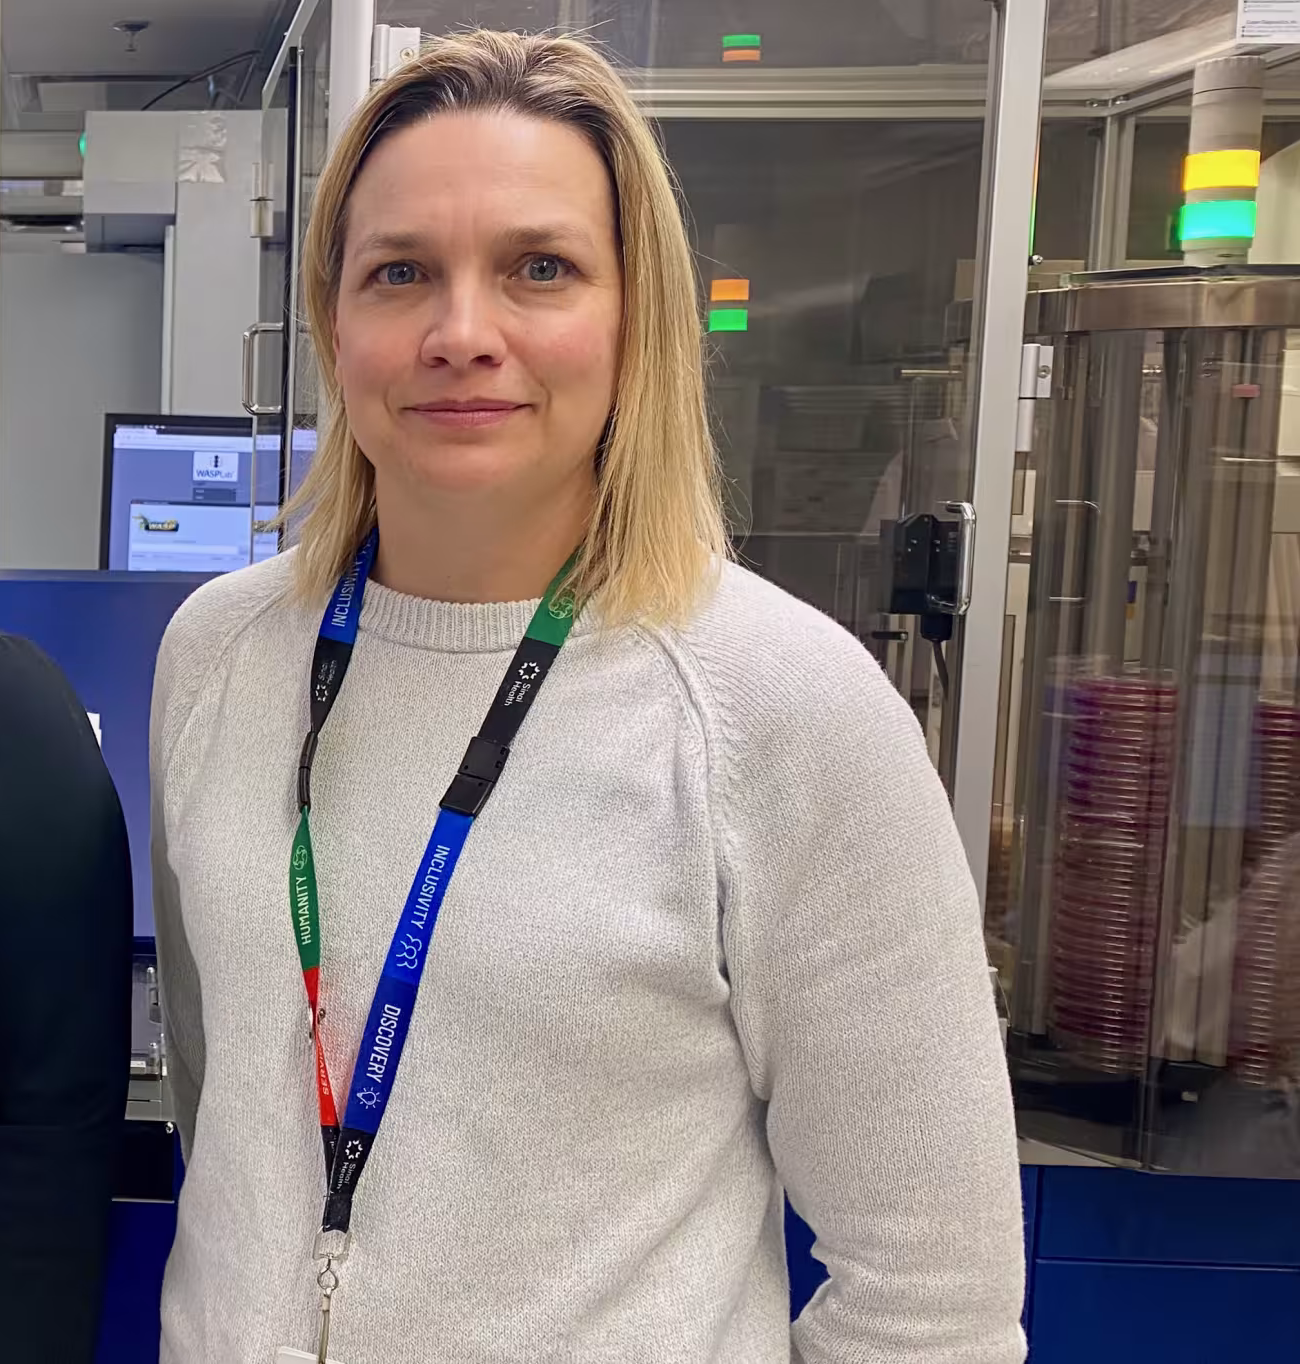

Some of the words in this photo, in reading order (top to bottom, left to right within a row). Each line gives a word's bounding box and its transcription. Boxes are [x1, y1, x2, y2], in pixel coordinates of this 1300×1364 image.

[504, 680, 523, 706] Health
[515, 682, 531, 703] Sinai
[411, 844, 451, 930] INCLUSIVITY
[295, 876, 312, 946] HUMANITY
[366, 1003, 401, 1084] DISCOVERY
[337, 1161, 350, 1190] Health
[345, 1163, 357, 1185] Sinai
